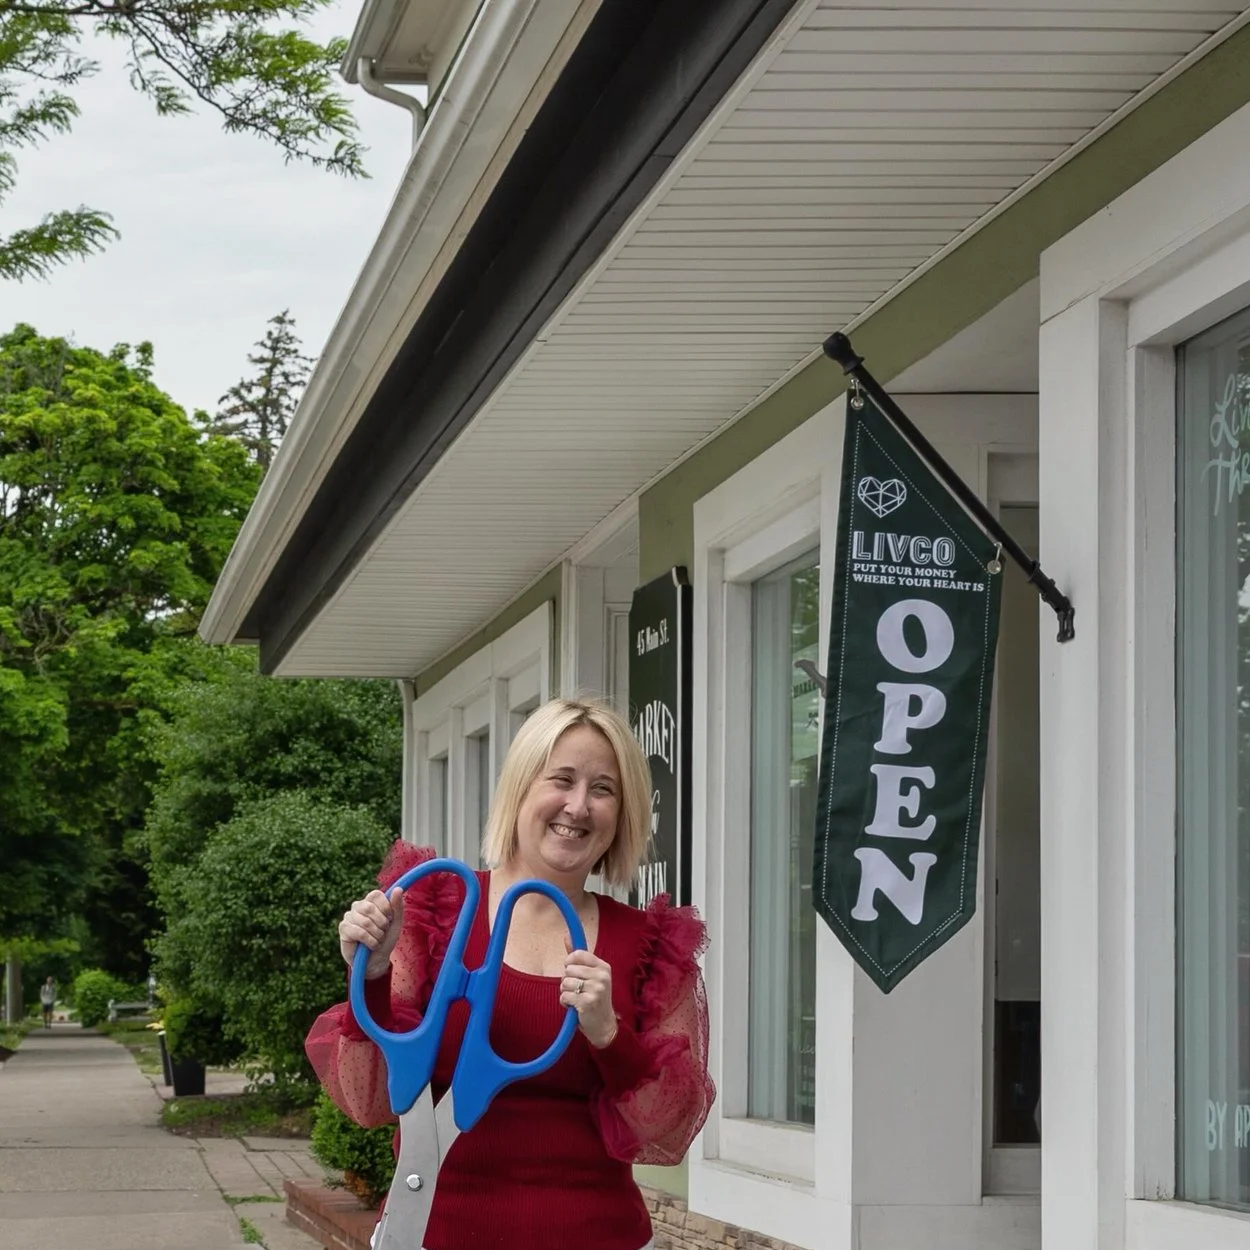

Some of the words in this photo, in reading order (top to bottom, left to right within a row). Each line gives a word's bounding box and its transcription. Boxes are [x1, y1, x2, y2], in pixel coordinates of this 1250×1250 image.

[851, 530, 956, 567] LIVCO
[852, 573, 896, 585] WHERE
[898, 577, 931, 588] YOUR
[933, 579, 971, 591] HEART
[972, 582, 985, 592] IS
[853, 563, 878, 573] PUT
[880, 564, 913, 576] YOUR
[914, 567, 957, 579] MONEY
[850, 598, 955, 925] OPEN
[1205, 1098, 1228, 1152] BY
